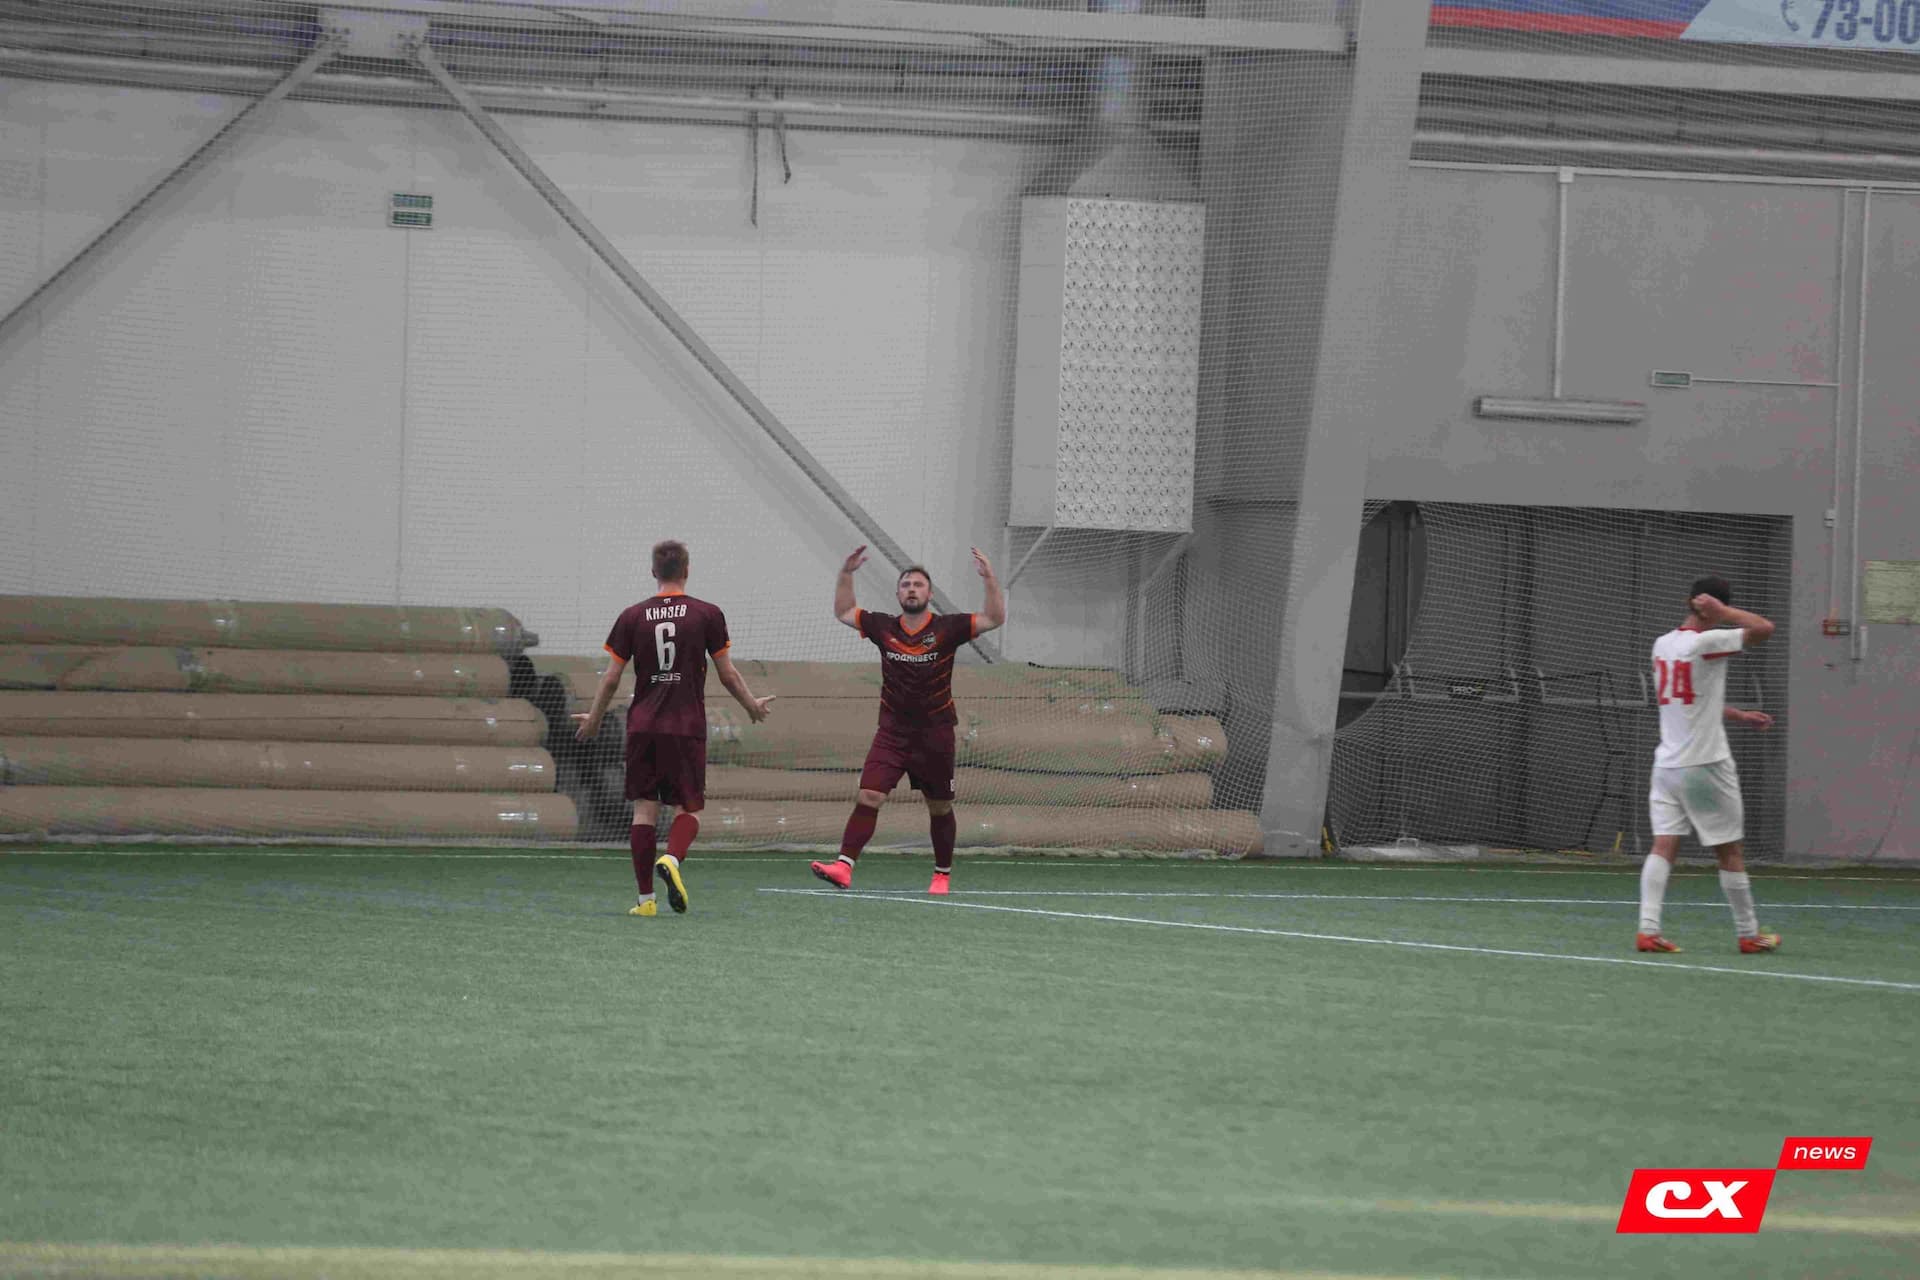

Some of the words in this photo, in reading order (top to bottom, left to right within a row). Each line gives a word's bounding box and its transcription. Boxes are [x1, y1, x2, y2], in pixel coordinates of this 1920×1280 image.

[645, 604, 688, 622] КНЯЗЕВ
[654, 621, 676, 671] 6
[1653, 656, 1697, 706] 24
